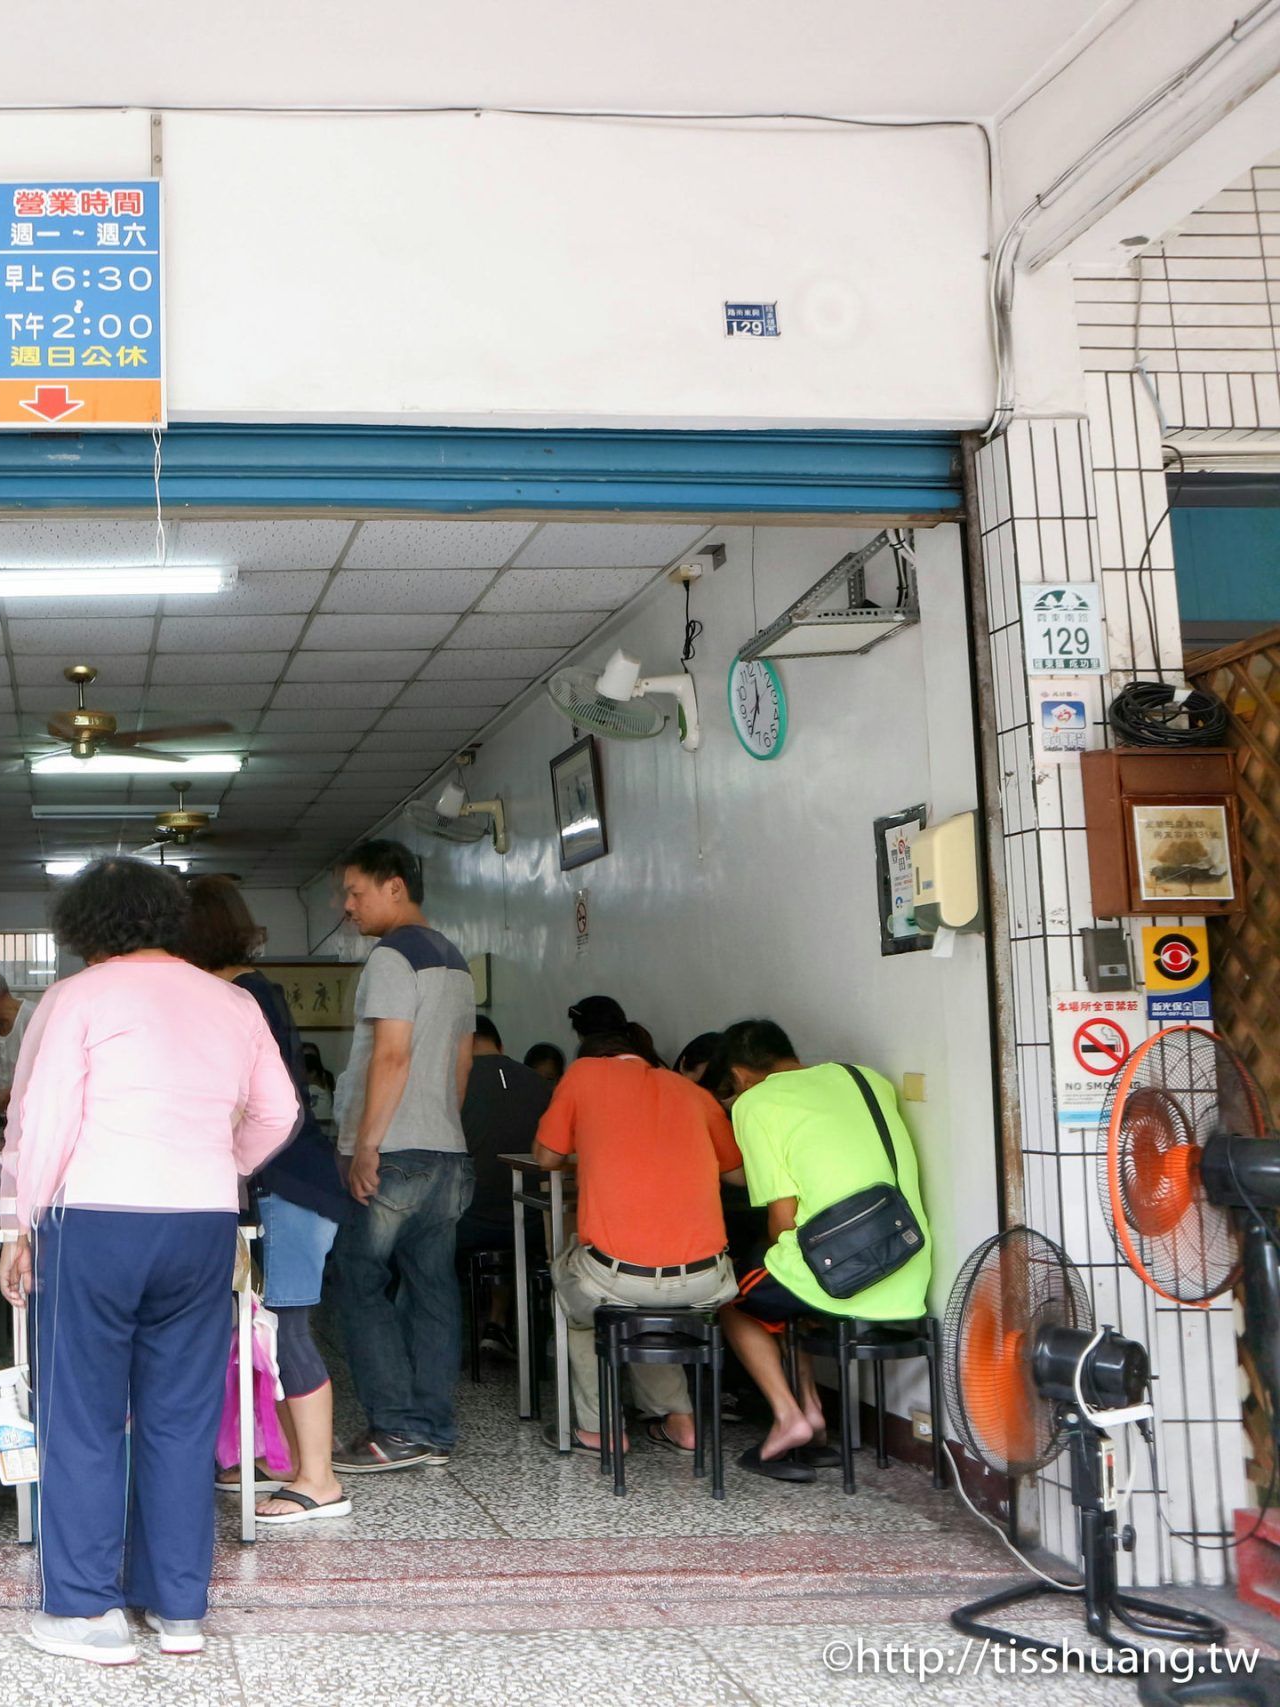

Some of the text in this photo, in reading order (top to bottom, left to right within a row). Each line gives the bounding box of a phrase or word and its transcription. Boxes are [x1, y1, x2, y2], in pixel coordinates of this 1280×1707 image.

[15, 189, 143, 217] 營業時間
[4, 264, 154, 292] 早上6:30
[4, 313, 154, 341] 下午2:00
[732, 321, 762, 335] 129
[10, 346, 149, 368] 週日公休
[1042, 627, 1089, 655] 129
[1065, 1082, 1081, 1090] NO
